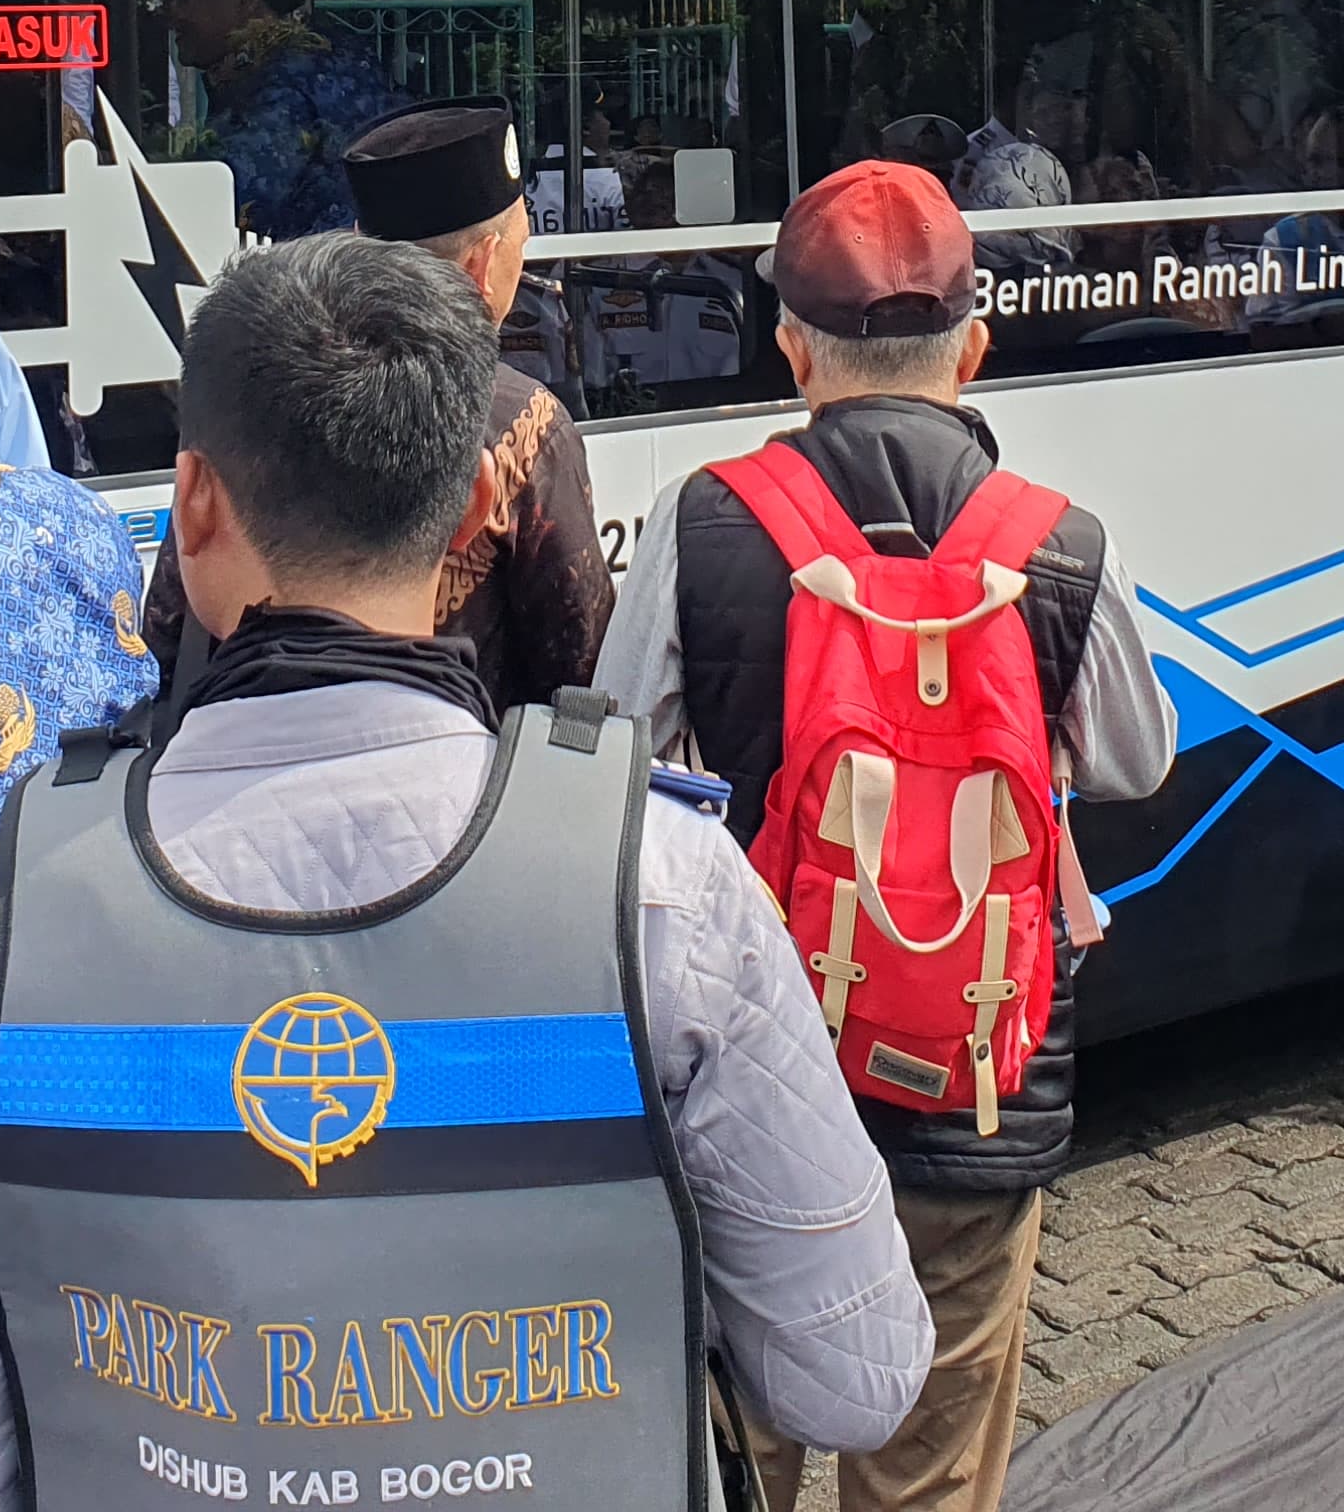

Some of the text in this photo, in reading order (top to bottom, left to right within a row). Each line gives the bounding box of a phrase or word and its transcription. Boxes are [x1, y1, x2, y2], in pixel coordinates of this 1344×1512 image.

[972, 264, 1138, 317] Beriman
[1153, 245, 1283, 304] Ramah
[58, 1284, 621, 1428] PARK RANGER
[137, 1436, 533, 1506] DISHUB KAB BOGOR
